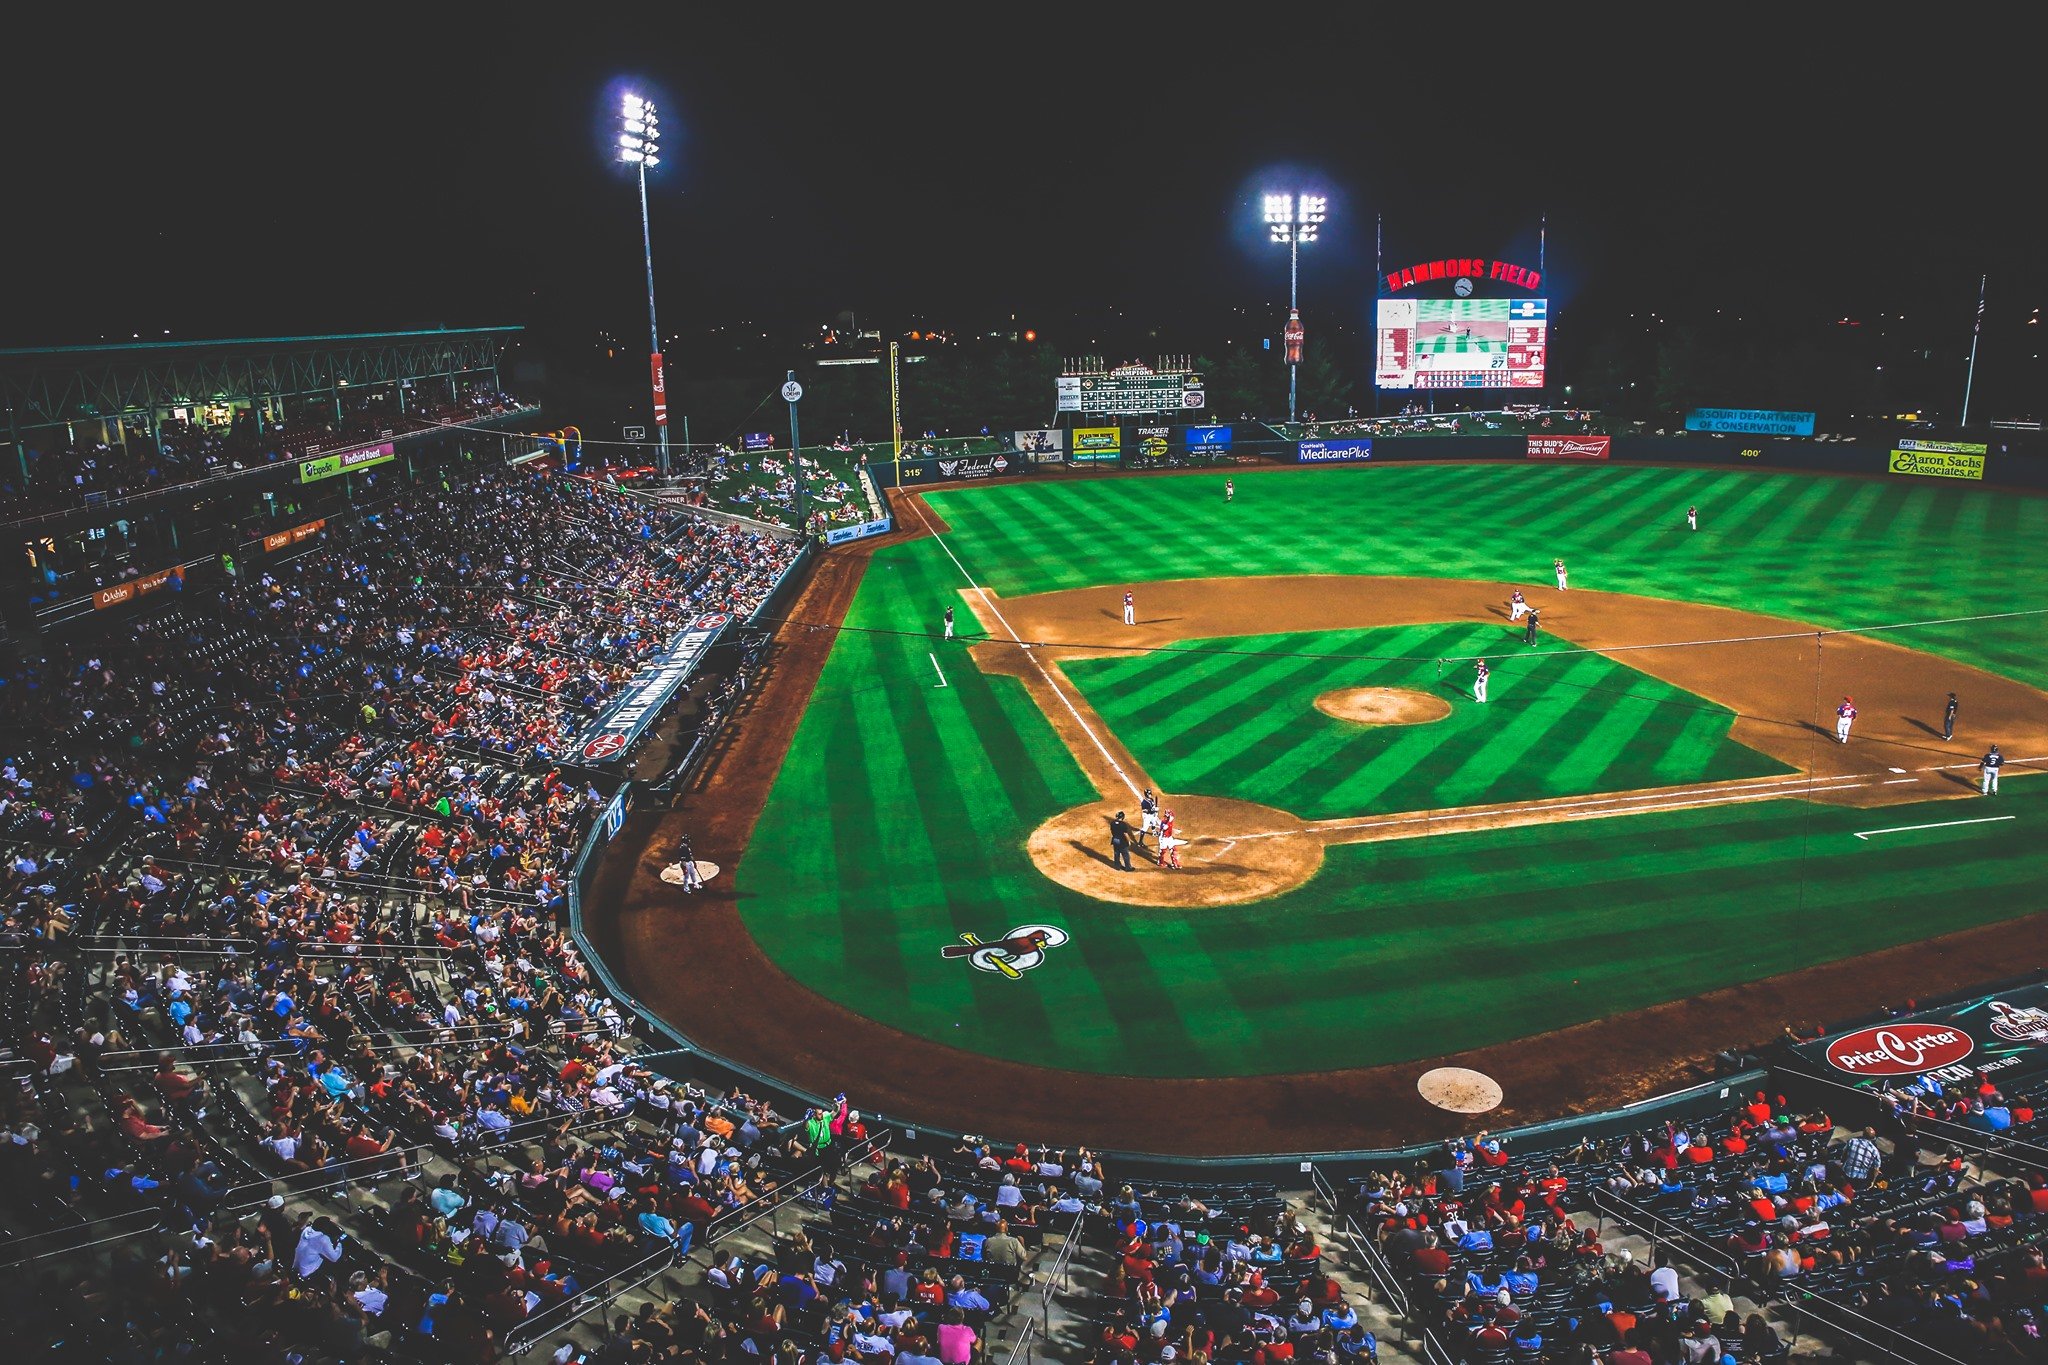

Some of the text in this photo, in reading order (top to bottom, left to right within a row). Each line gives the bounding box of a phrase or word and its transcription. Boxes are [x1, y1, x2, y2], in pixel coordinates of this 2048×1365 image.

[1387, 259, 1541, 292] HAMMONS FIELD
[1491, 360, 1504, 369] 27
[1740, 411, 1812, 423] DEPARTMENT
[1700, 421, 1796, 432] OF CONSERVATION
[1300, 446, 1369, 459] MedicarePlus
[1565, 444, 1602, 452] Budweiser
[1741, 449, 1761, 457] 400'
[344, 449, 380, 465] Redbird Roost
[1908, 453, 1981, 468] Aaron Sachs
[958, 457, 994, 471] Federal
[904, 468, 922, 478] 315'
[110, 588, 128, 599] Ashley
[604, 704, 651, 729] FIELD
[607, 799, 623, 839] KY3
[1977, 1062, 2004, 1073] SINCE
[1445, 1203, 1458, 1211] KOZMA
